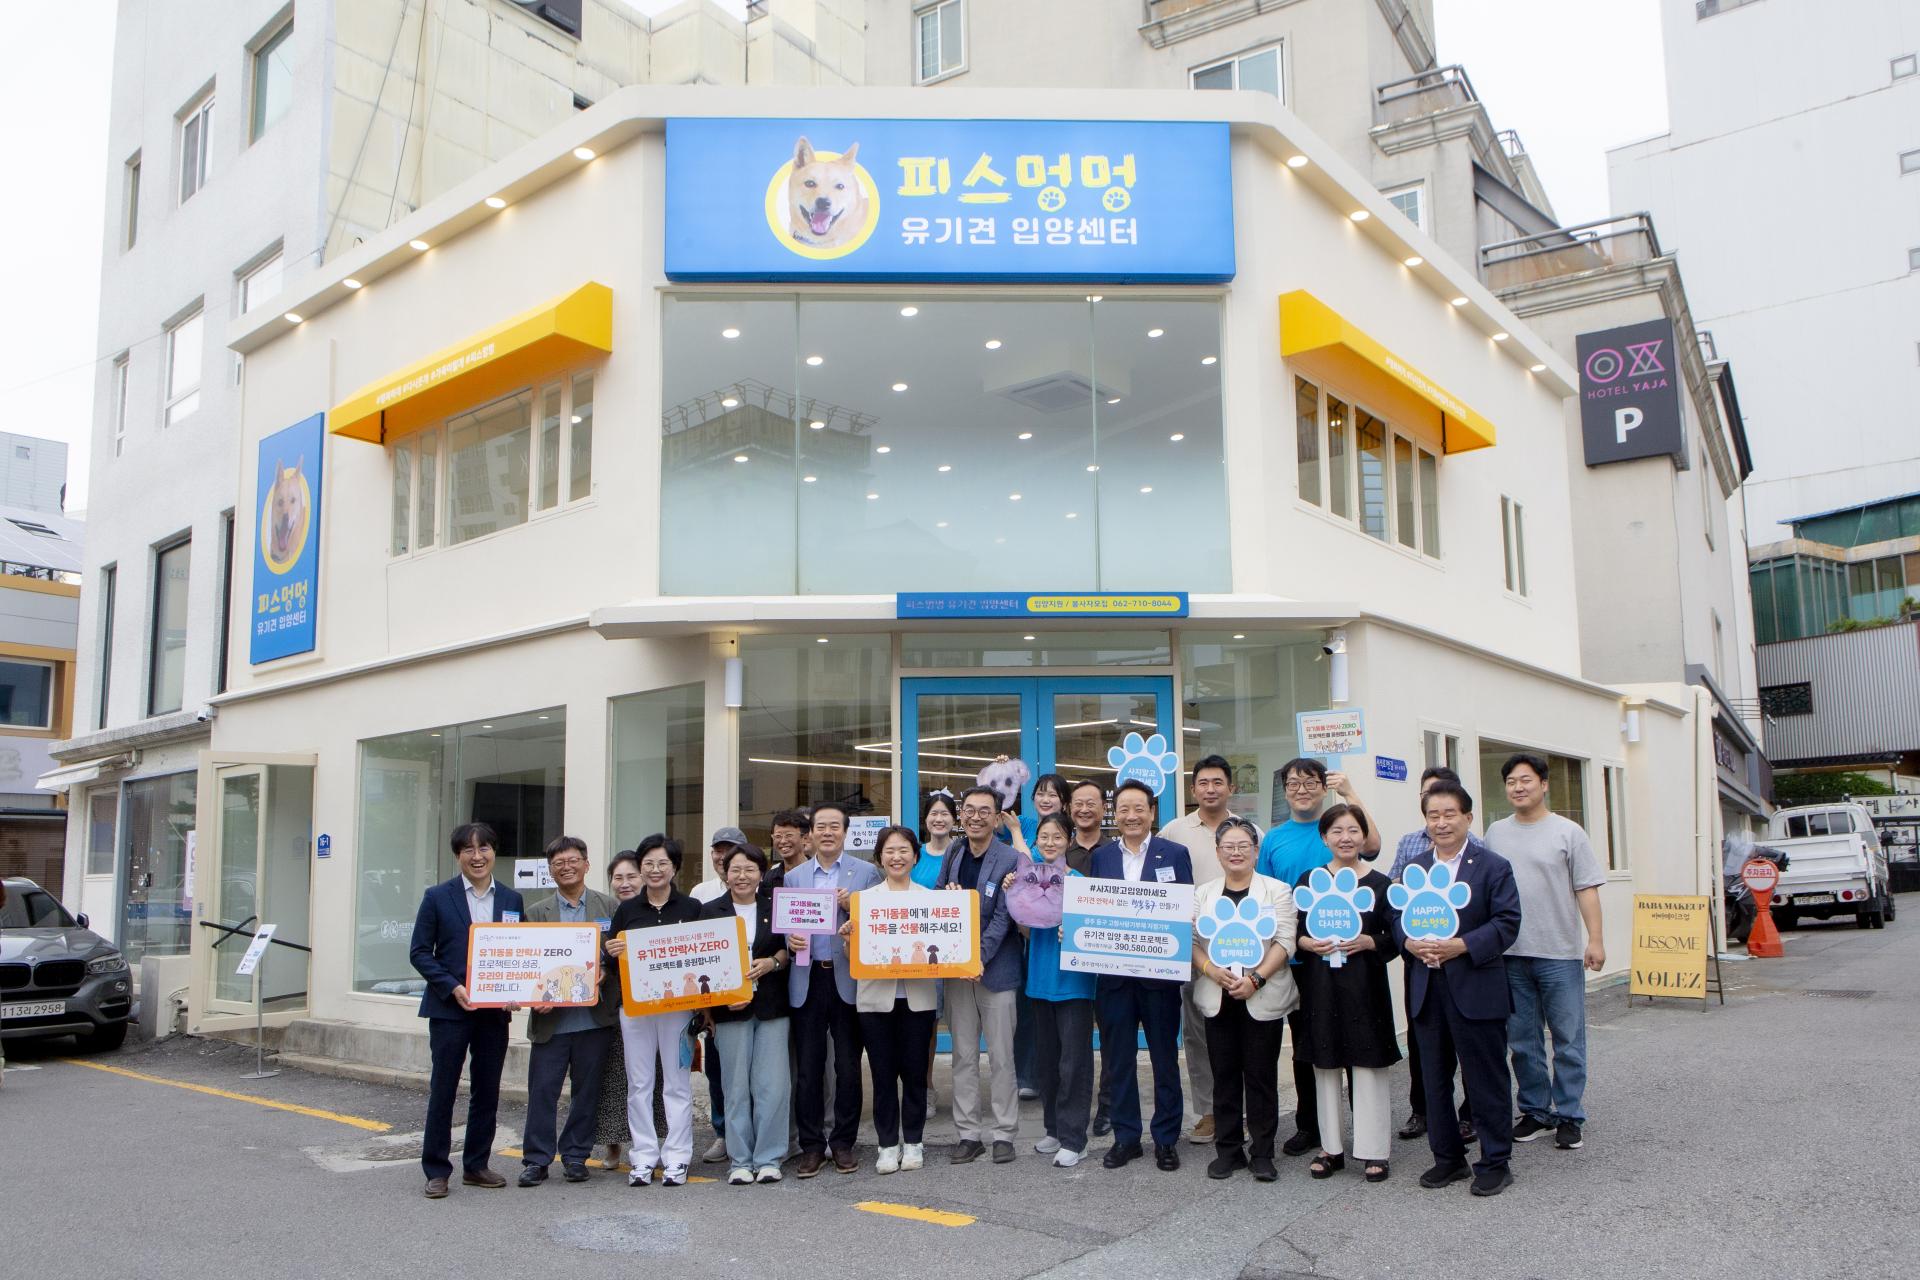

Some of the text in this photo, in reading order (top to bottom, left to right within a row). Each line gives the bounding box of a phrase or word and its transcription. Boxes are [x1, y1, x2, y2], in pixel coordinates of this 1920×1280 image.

[897, 152, 1138, 212] 피스멍멍
[901, 217, 1138, 246] 유기견 입양센터
[1588, 378, 1668, 400] HOTEL YAJA
[1615, 407, 1643, 444] P
[257, 579, 308, 614] 피스멍멍
[1112, 600, 1172, 608] 062-710-8044
[257, 610, 306, 636] 유기견 입양센터
[1746, 868, 1772, 877] 주차금지
[1412, 906, 1446, 915] HAPPY
[1638, 901, 1705, 911] BABA MAKEUP
[870, 907, 961, 920] 유기동물에게 새로운
[868, 922, 962, 935] 가족을 선물해주세요!
[1411, 918, 1449, 928] 피스멍멍
[649, 936, 672, 946] 반려동물
[703, 931, 715, 939] 위한
[1084, 930, 1169, 945] 유기견 입양 촉진 프로젝트
[1639, 935, 1700, 951] LISSOME
[479, 948, 573, 957] 유기동물 안락사 ZERO
[637, 939, 729, 961] 유기견 안락사 ZERO
[1114, 943, 1163, 954] 390,580,000
[478, 960, 520, 969] 프로젝트의
[649, 956, 721, 972] 프로젝트를 응원합니다!
[477, 971, 542, 981] 우리의 관심에서
[1636, 970, 1701, 989] VOLEZ
[477, 983, 522, 992] 시작합니다.
[34, 1004, 61, 1015] 2958
